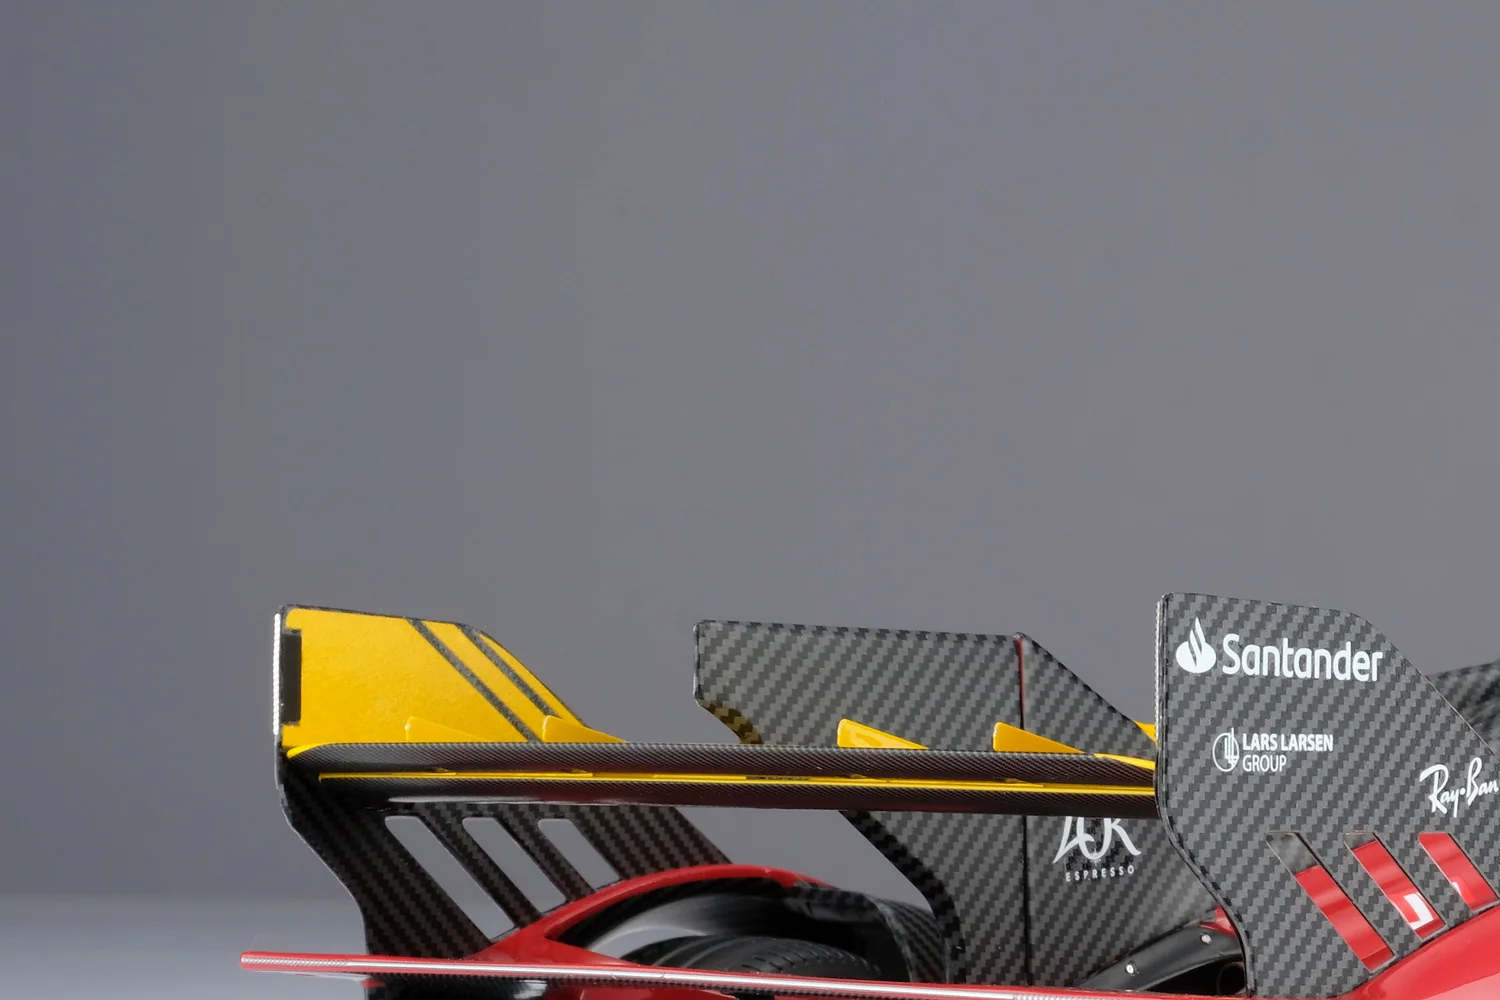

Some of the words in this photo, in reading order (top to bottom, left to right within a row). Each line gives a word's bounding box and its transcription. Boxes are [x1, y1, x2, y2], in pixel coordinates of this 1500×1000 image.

[1221, 633, 1384, 682] Santander
[1242, 733, 1278, 751] LARS
[1280, 733, 1334, 752] LARSEN
[1242, 754, 1287, 773] GROUP
[1065, 865, 1135, 882] ESPRESSO
